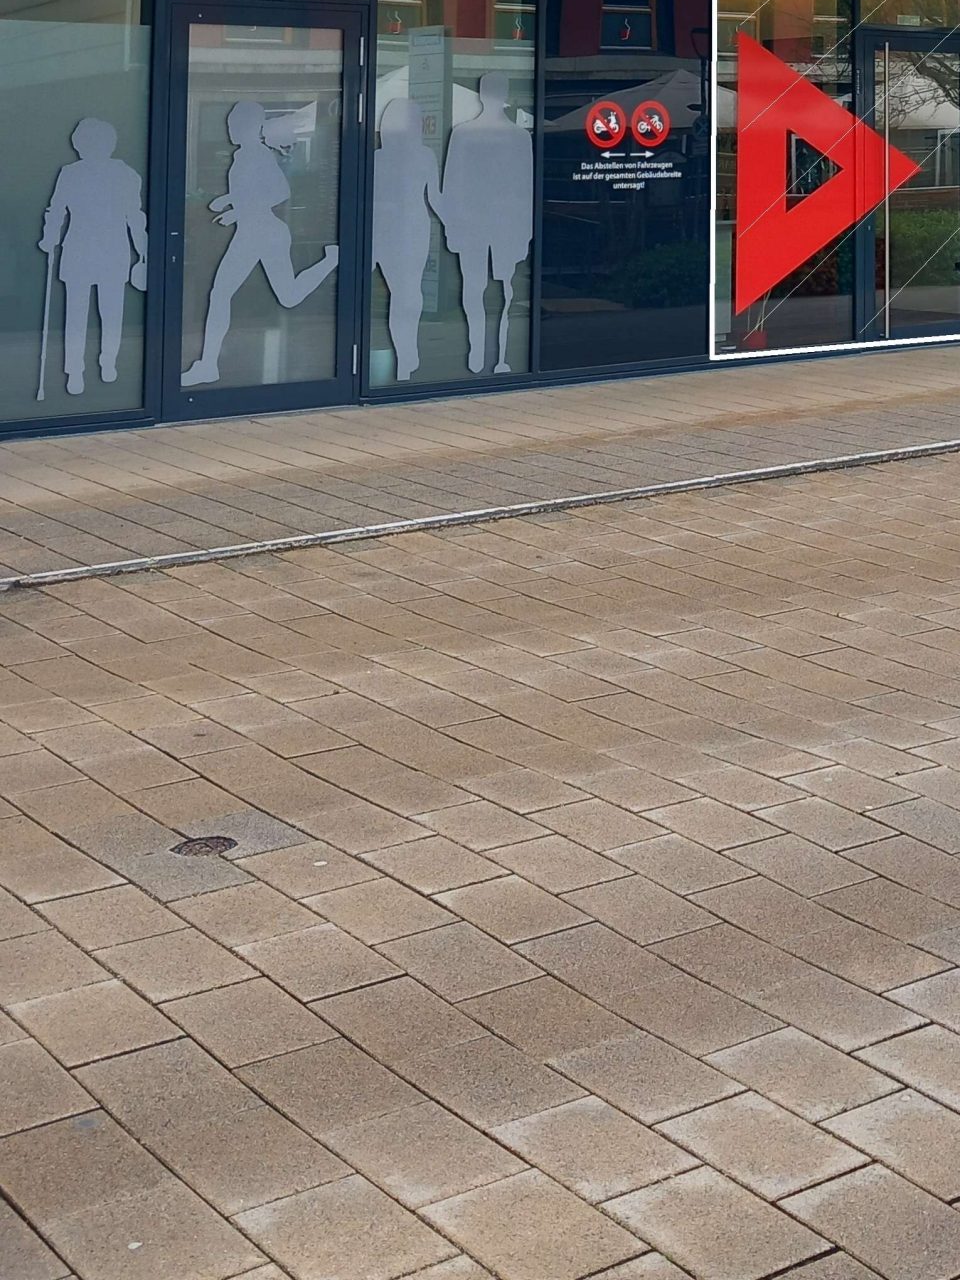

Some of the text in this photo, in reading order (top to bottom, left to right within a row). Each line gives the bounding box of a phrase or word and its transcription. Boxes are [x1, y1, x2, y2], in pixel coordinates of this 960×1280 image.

[581, 162, 593, 170] Das
[594, 162, 624, 170] Abstellen
[637, 161, 673, 171] Fahrzeugen
[581, 172, 593, 180] auf
[593, 172, 604, 180] der
[605, 172, 636, 181] gesamten
[637, 171, 682, 179] Gebäudebreite
[613, 181, 646, 191] untersagt!
